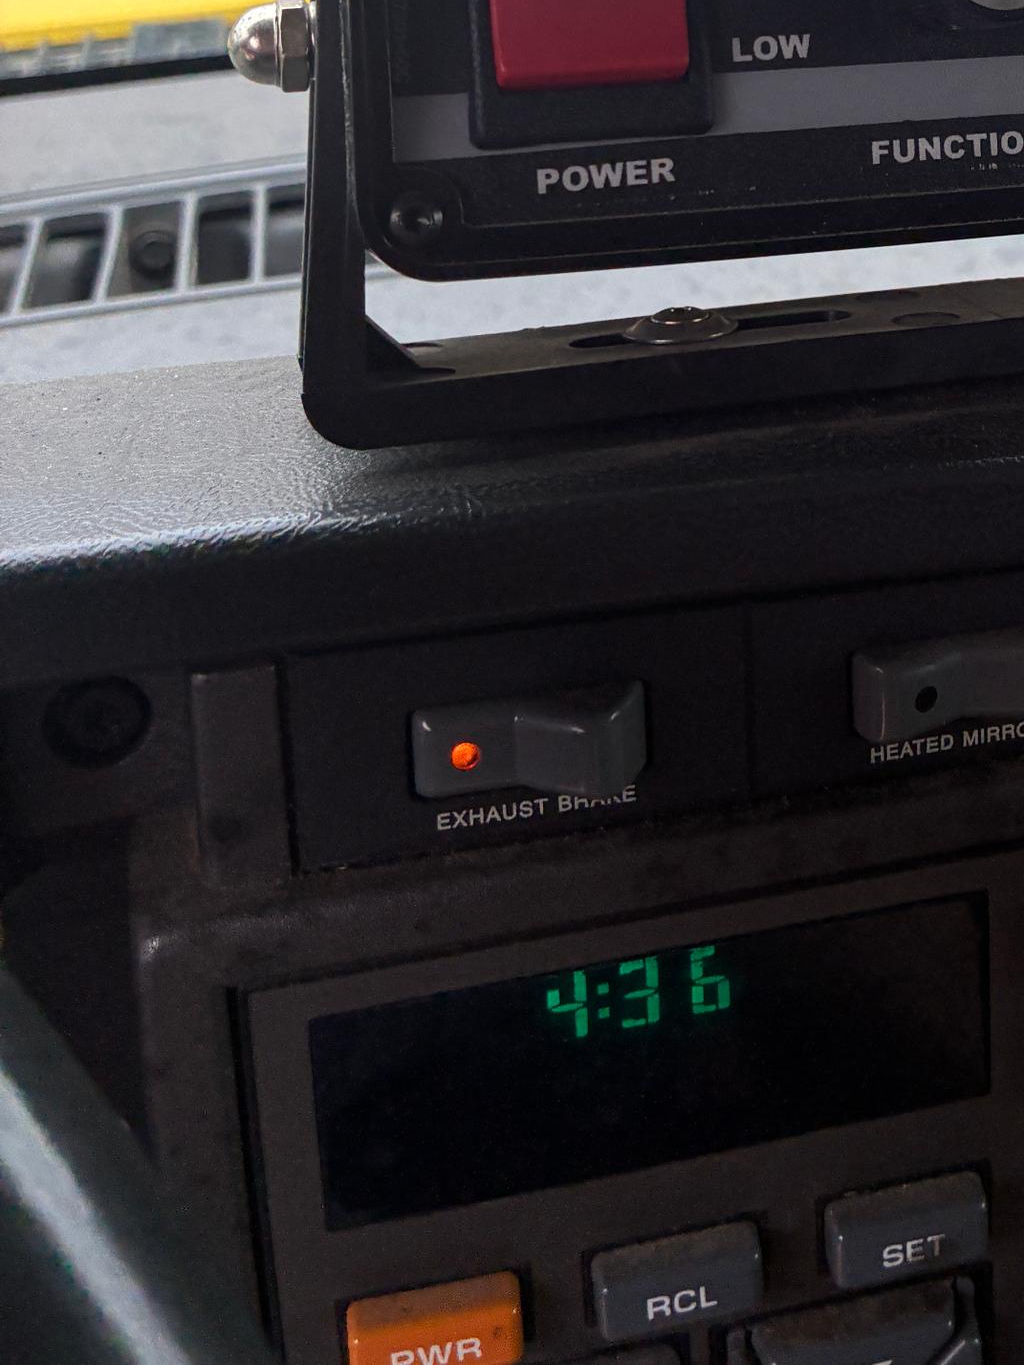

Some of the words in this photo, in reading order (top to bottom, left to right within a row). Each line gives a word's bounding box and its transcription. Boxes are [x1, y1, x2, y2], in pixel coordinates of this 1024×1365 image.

[731, 34, 811, 63] LOW
[536, 157, 676, 195] POWER
[869, 734, 954, 764] HEATED
[435, 797, 549, 832] EXHAUST
[546, 945, 732, 1038] 4:36
[881, 1234, 946, 1269] SET
[646, 1287, 718, 1322] RCL
